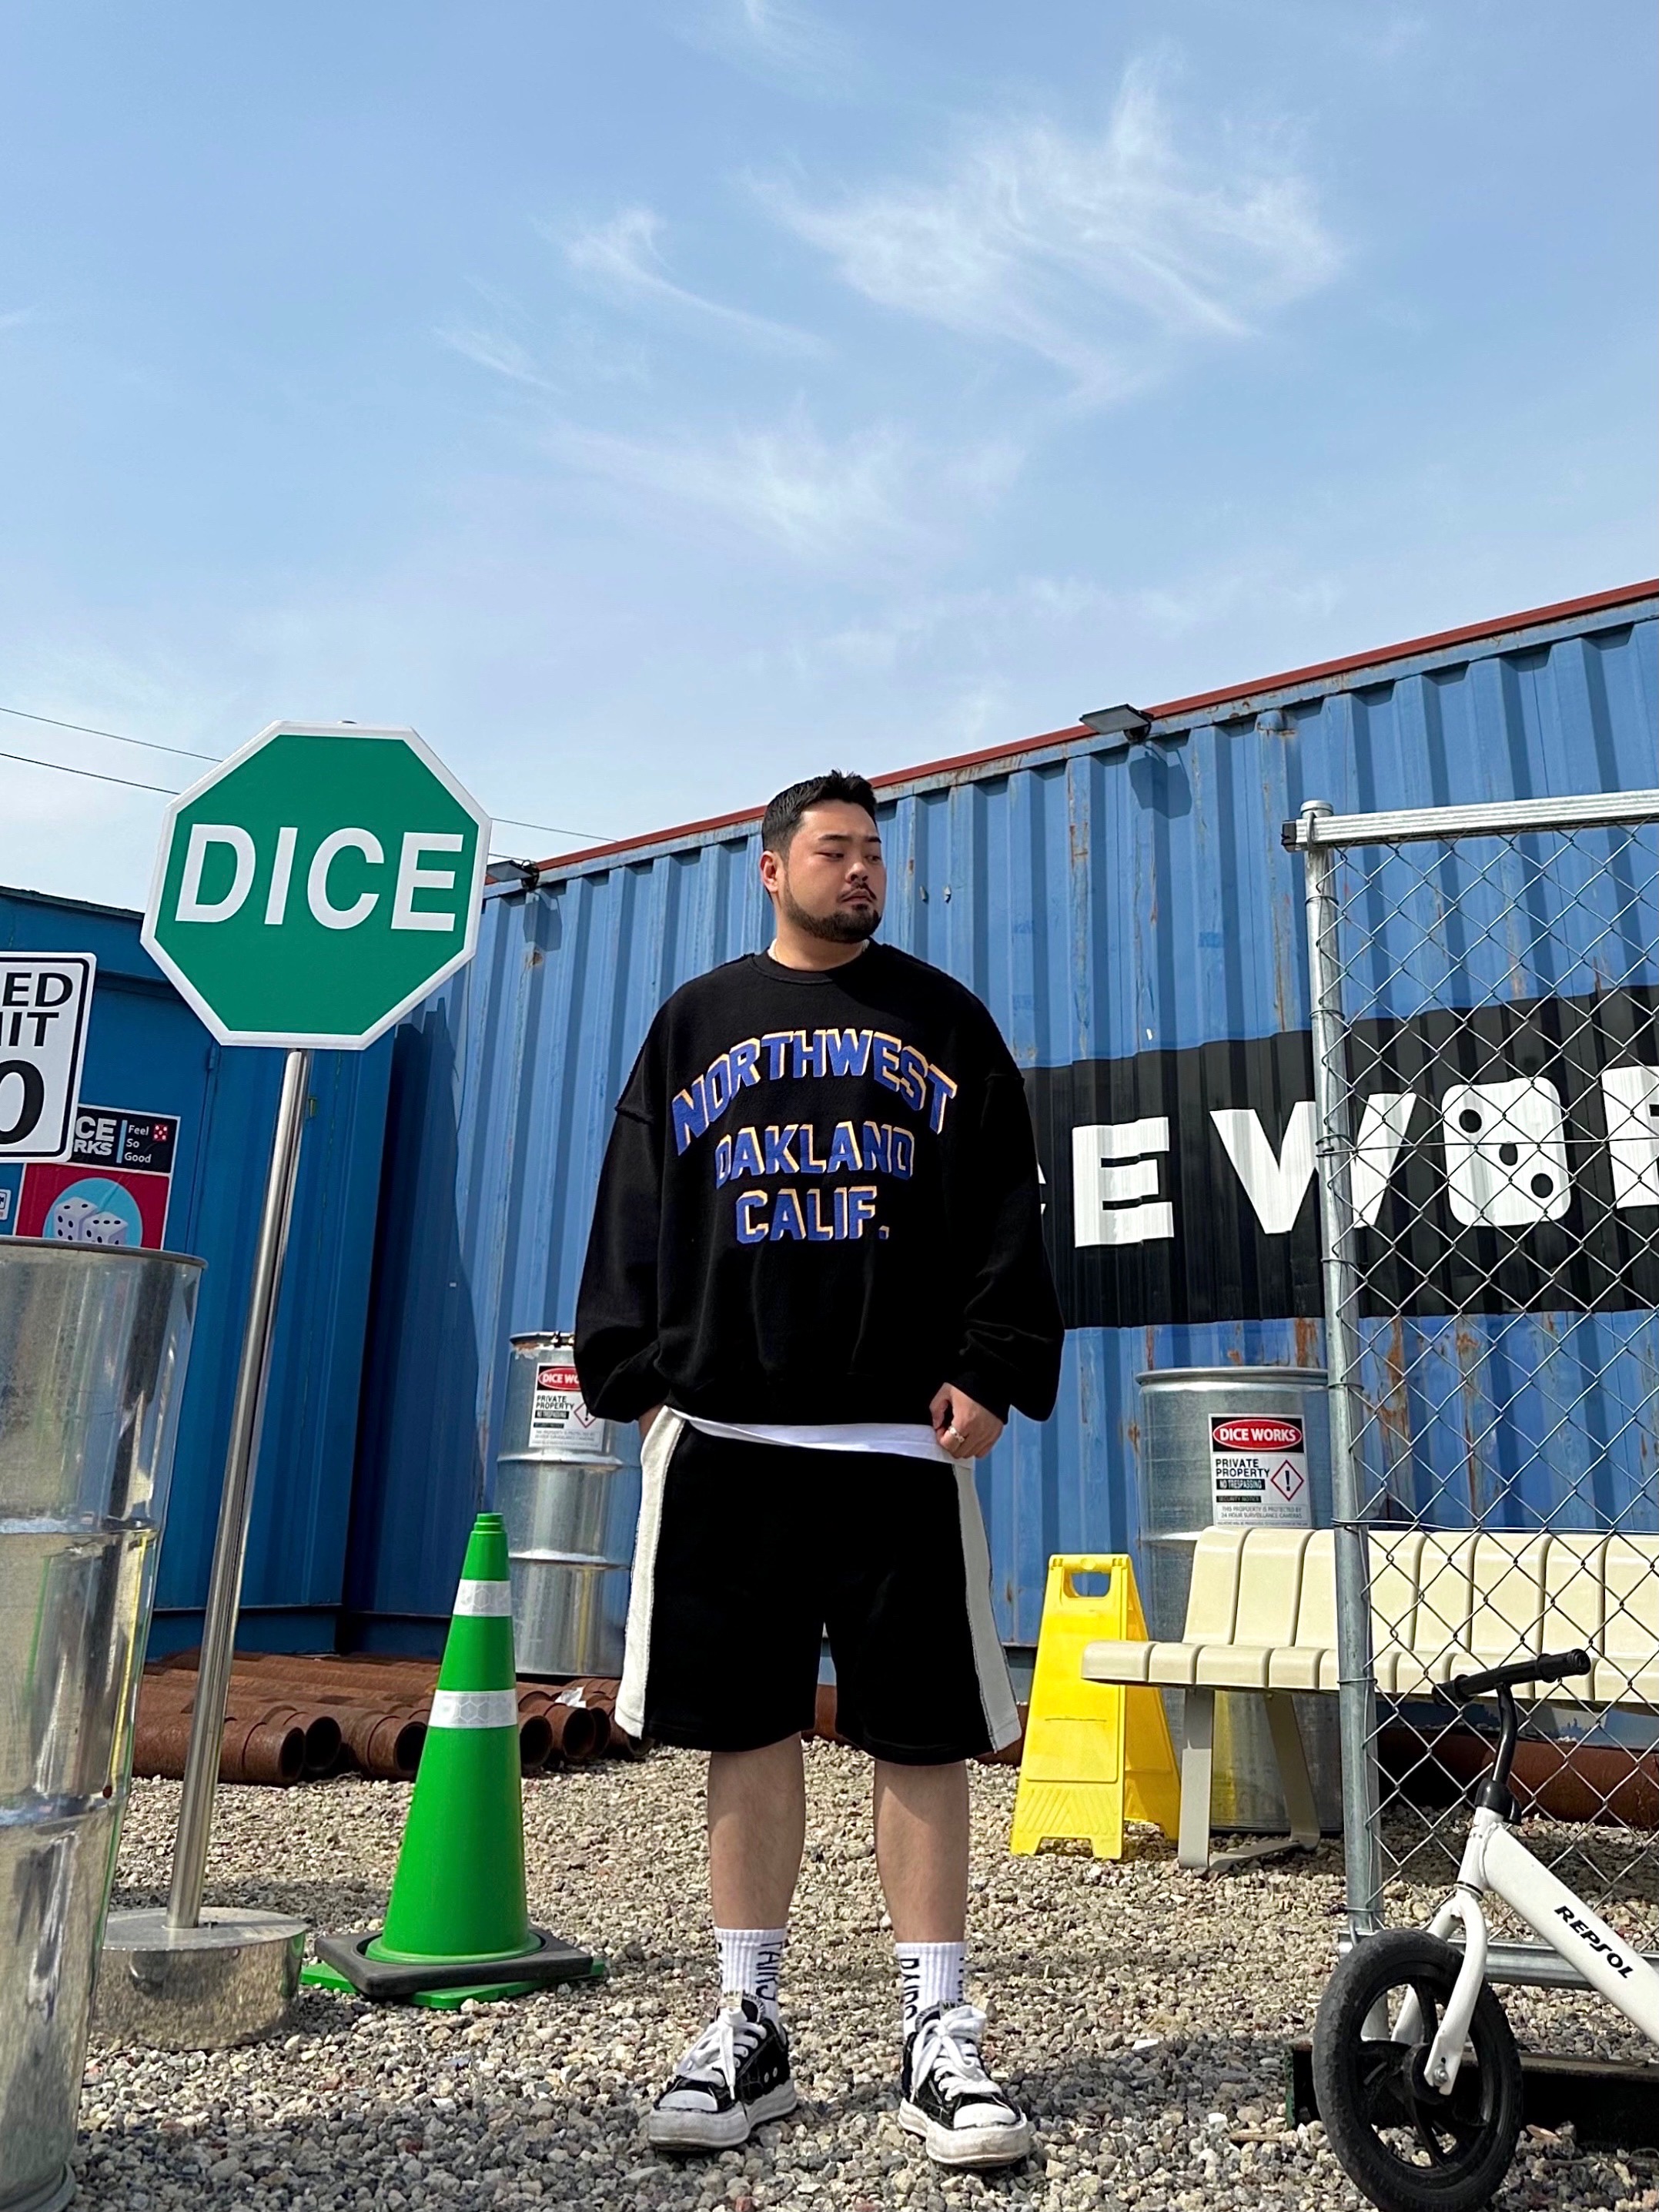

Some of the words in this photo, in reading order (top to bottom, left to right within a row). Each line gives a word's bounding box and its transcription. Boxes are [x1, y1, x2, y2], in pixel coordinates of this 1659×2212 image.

[175, 823, 464, 932] DICE
[2, 972, 73, 1007] ED
[0, 1011, 59, 1047] IT
[672, 1028, 958, 1156] NORTHWEST
[128, 1124, 149, 1136] Feel
[125, 1138, 140, 1148] So
[124, 1152, 152, 1163] Good
[714, 1120, 915, 1190] OAKLAND
[736, 1186, 889, 1243] CALIF.
[542, 1374, 564, 1384] DICE
[536, 1402, 574, 1411] PROPERTY
[1219, 1427, 1249, 1441] DICE
[1250, 1427, 1296, 1442] WORKS
[1216, 1458, 1259, 1468] PRIVATE
[1216, 1468, 1270, 1477] PROPERTY
[1219, 1479, 1228, 1489] NO
[1228, 1479, 1263, 1489] TRESPASSING
[1554, 1906, 1634, 1979] REPSOL
